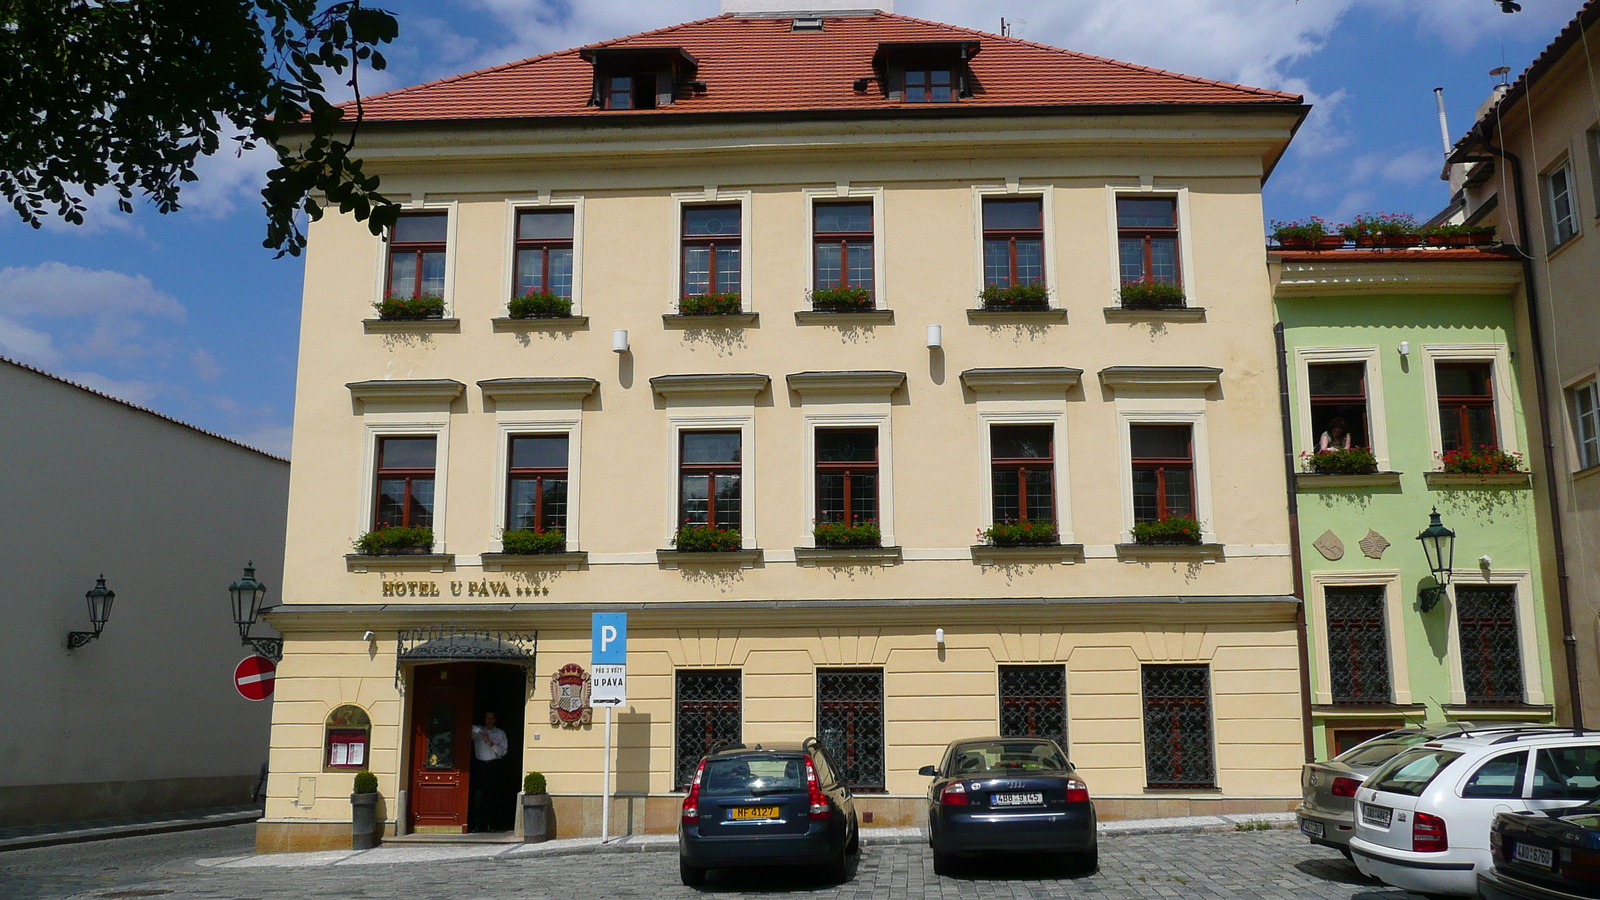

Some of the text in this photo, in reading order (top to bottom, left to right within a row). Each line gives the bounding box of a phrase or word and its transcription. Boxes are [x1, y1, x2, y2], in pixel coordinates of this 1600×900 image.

[381, 578, 511, 596] HOTEL U PÁVA
[601, 625, 617, 652] P
[593, 678, 599, 687] U
[602, 676, 623, 687] PÁVA
[562, 687, 570, 696] K
[571, 698, 579, 708] K
[1019, 793, 1039, 802] 9145
[737, 807, 774, 817] MF 4127
[1533, 848, 1550, 864] 6760
